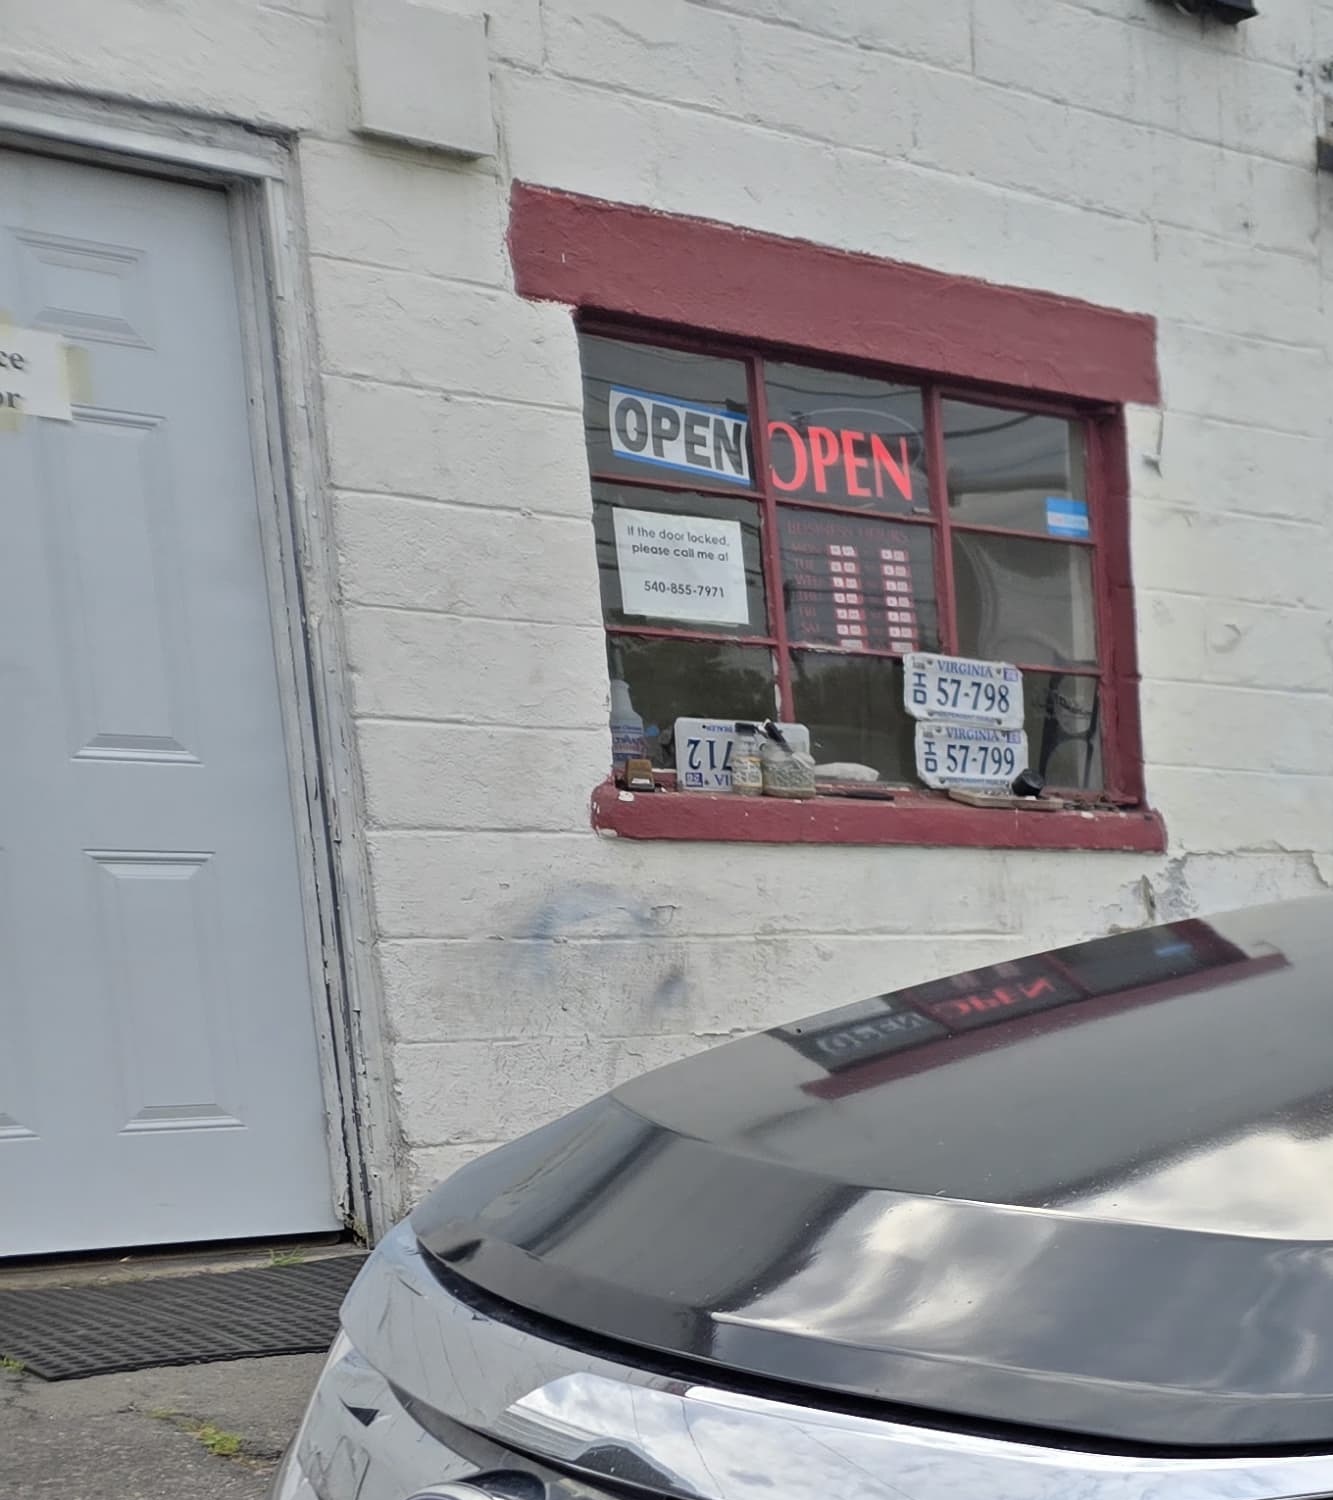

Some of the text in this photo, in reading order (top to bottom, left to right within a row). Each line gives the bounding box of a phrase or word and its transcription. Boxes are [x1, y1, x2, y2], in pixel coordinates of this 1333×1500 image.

[615, 397, 744, 476] OPEN
[768, 421, 912, 501] OPEN
[638, 527, 655, 538] the
[659, 530, 684, 541] door
[632, 544, 670, 556] please
[673, 547, 694, 559] call
[697, 551, 714, 561] me
[644, 580, 724, 598] 540-855-7971
[937, 660, 994, 678] VIRGINIA
[937, 677, 1010, 713] 57-798
[946, 727, 1000, 743] VIRGINIA
[947, 744, 1015, 776] 57-799
